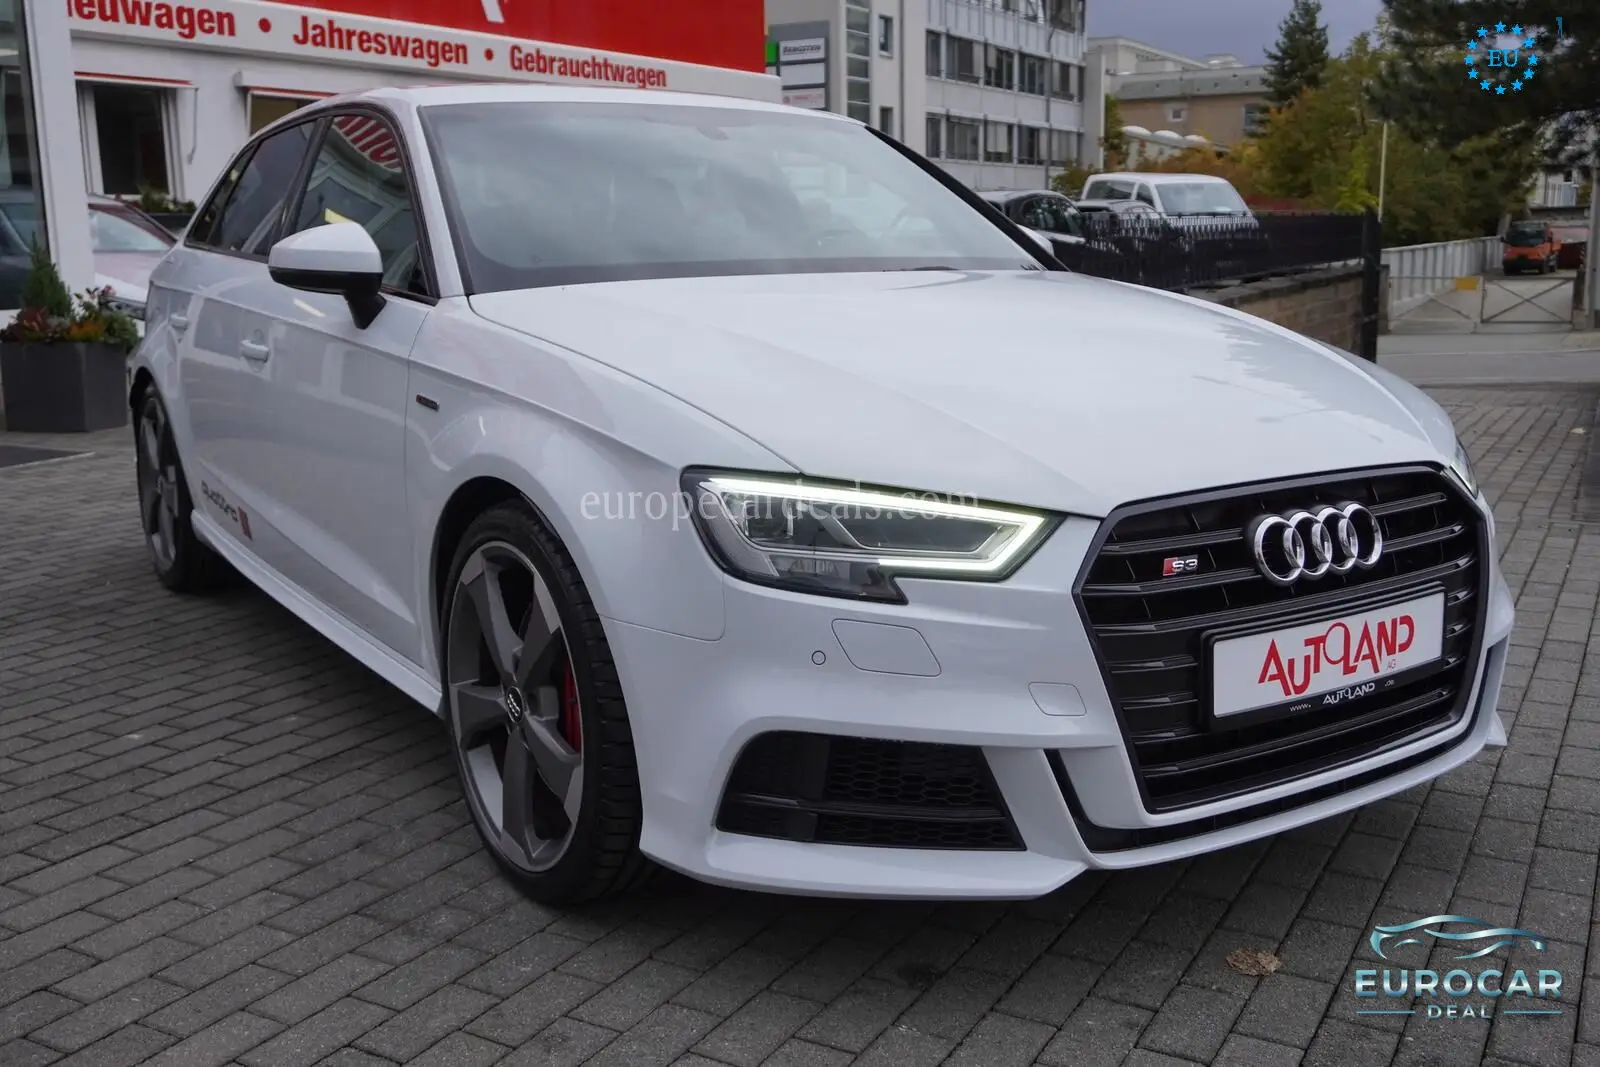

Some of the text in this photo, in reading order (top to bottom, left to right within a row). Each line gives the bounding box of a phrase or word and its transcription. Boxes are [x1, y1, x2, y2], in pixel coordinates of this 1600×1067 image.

[293, 15, 468, 67] Jahreswagen
[510, 45, 667, 88] Gebrauchtwagen
[1172, 558, 1198, 571] S3
